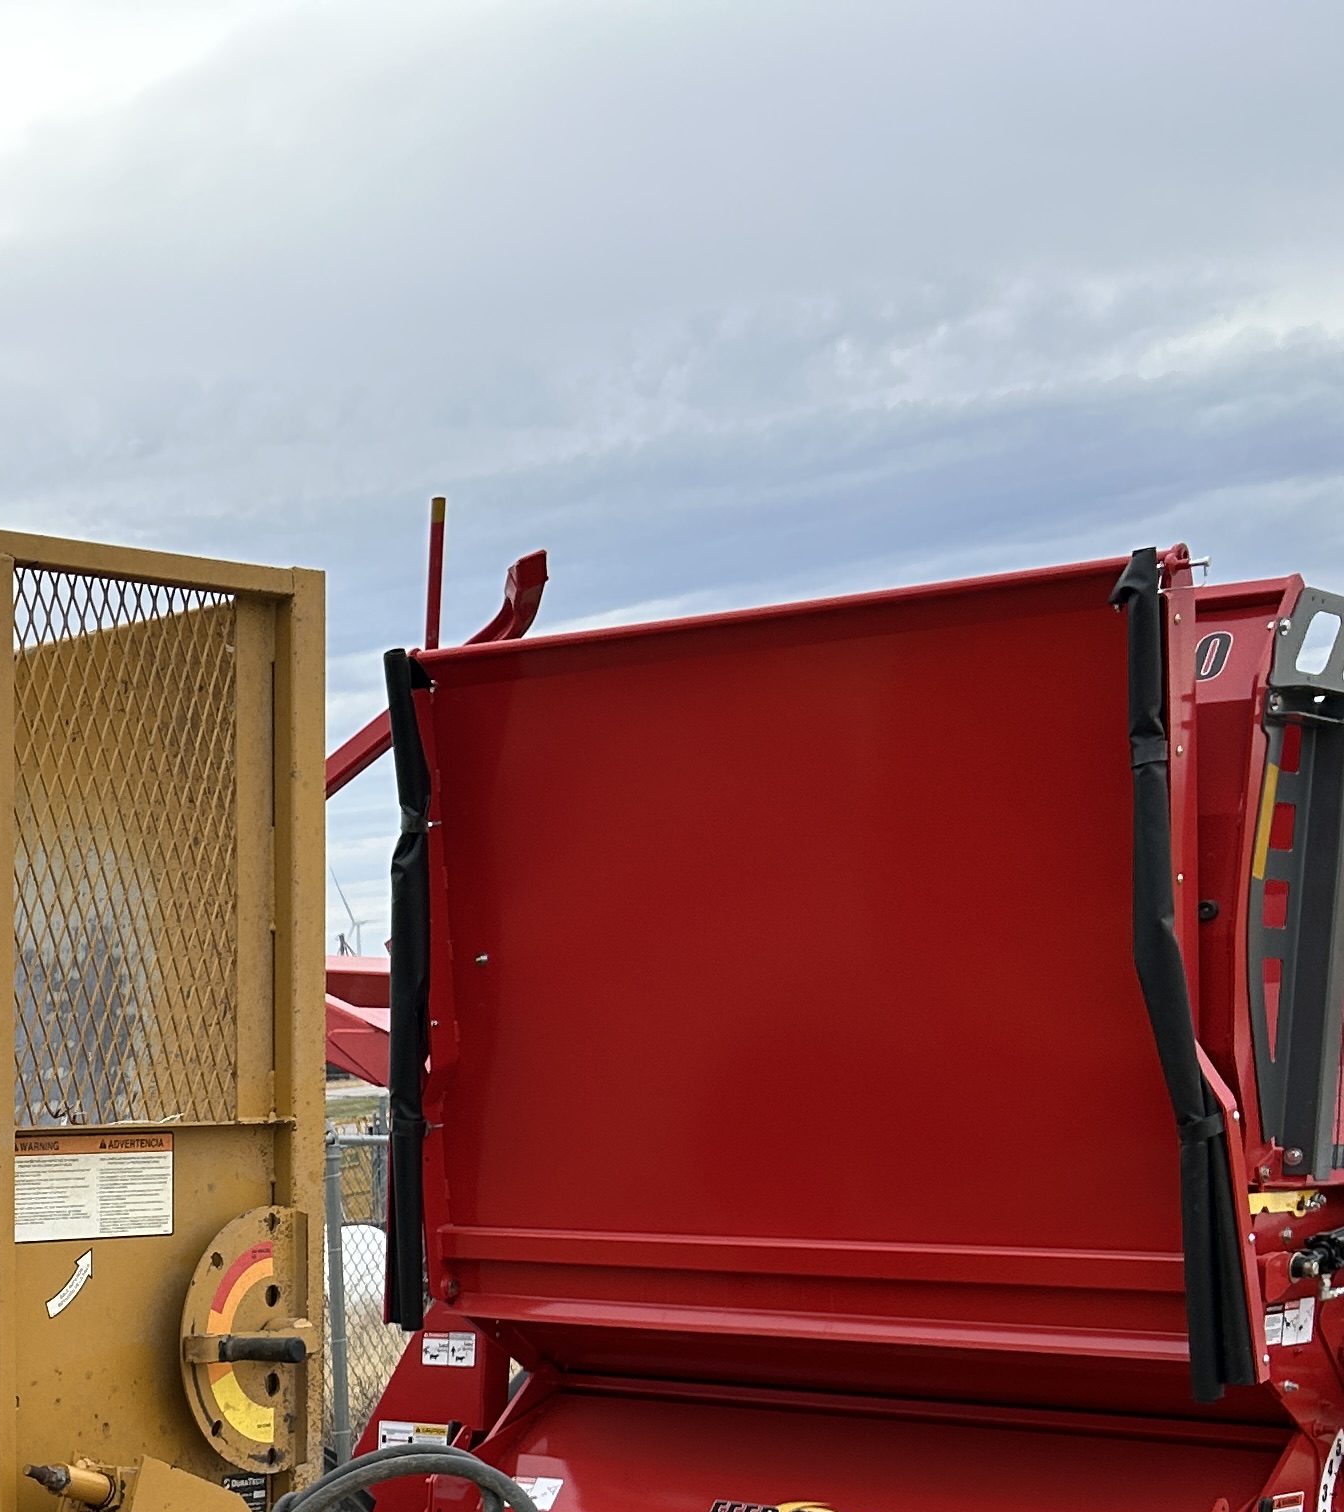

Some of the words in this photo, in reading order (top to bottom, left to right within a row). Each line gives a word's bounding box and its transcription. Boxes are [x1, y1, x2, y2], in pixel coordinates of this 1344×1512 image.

[20, 1141, 60, 1151] WARNING
[108, 1138, 164, 1149] ADVERTENCIA
[1327, 1459, 1334, 1477] 4
[1321, 1484, 1328, 1502] 3
